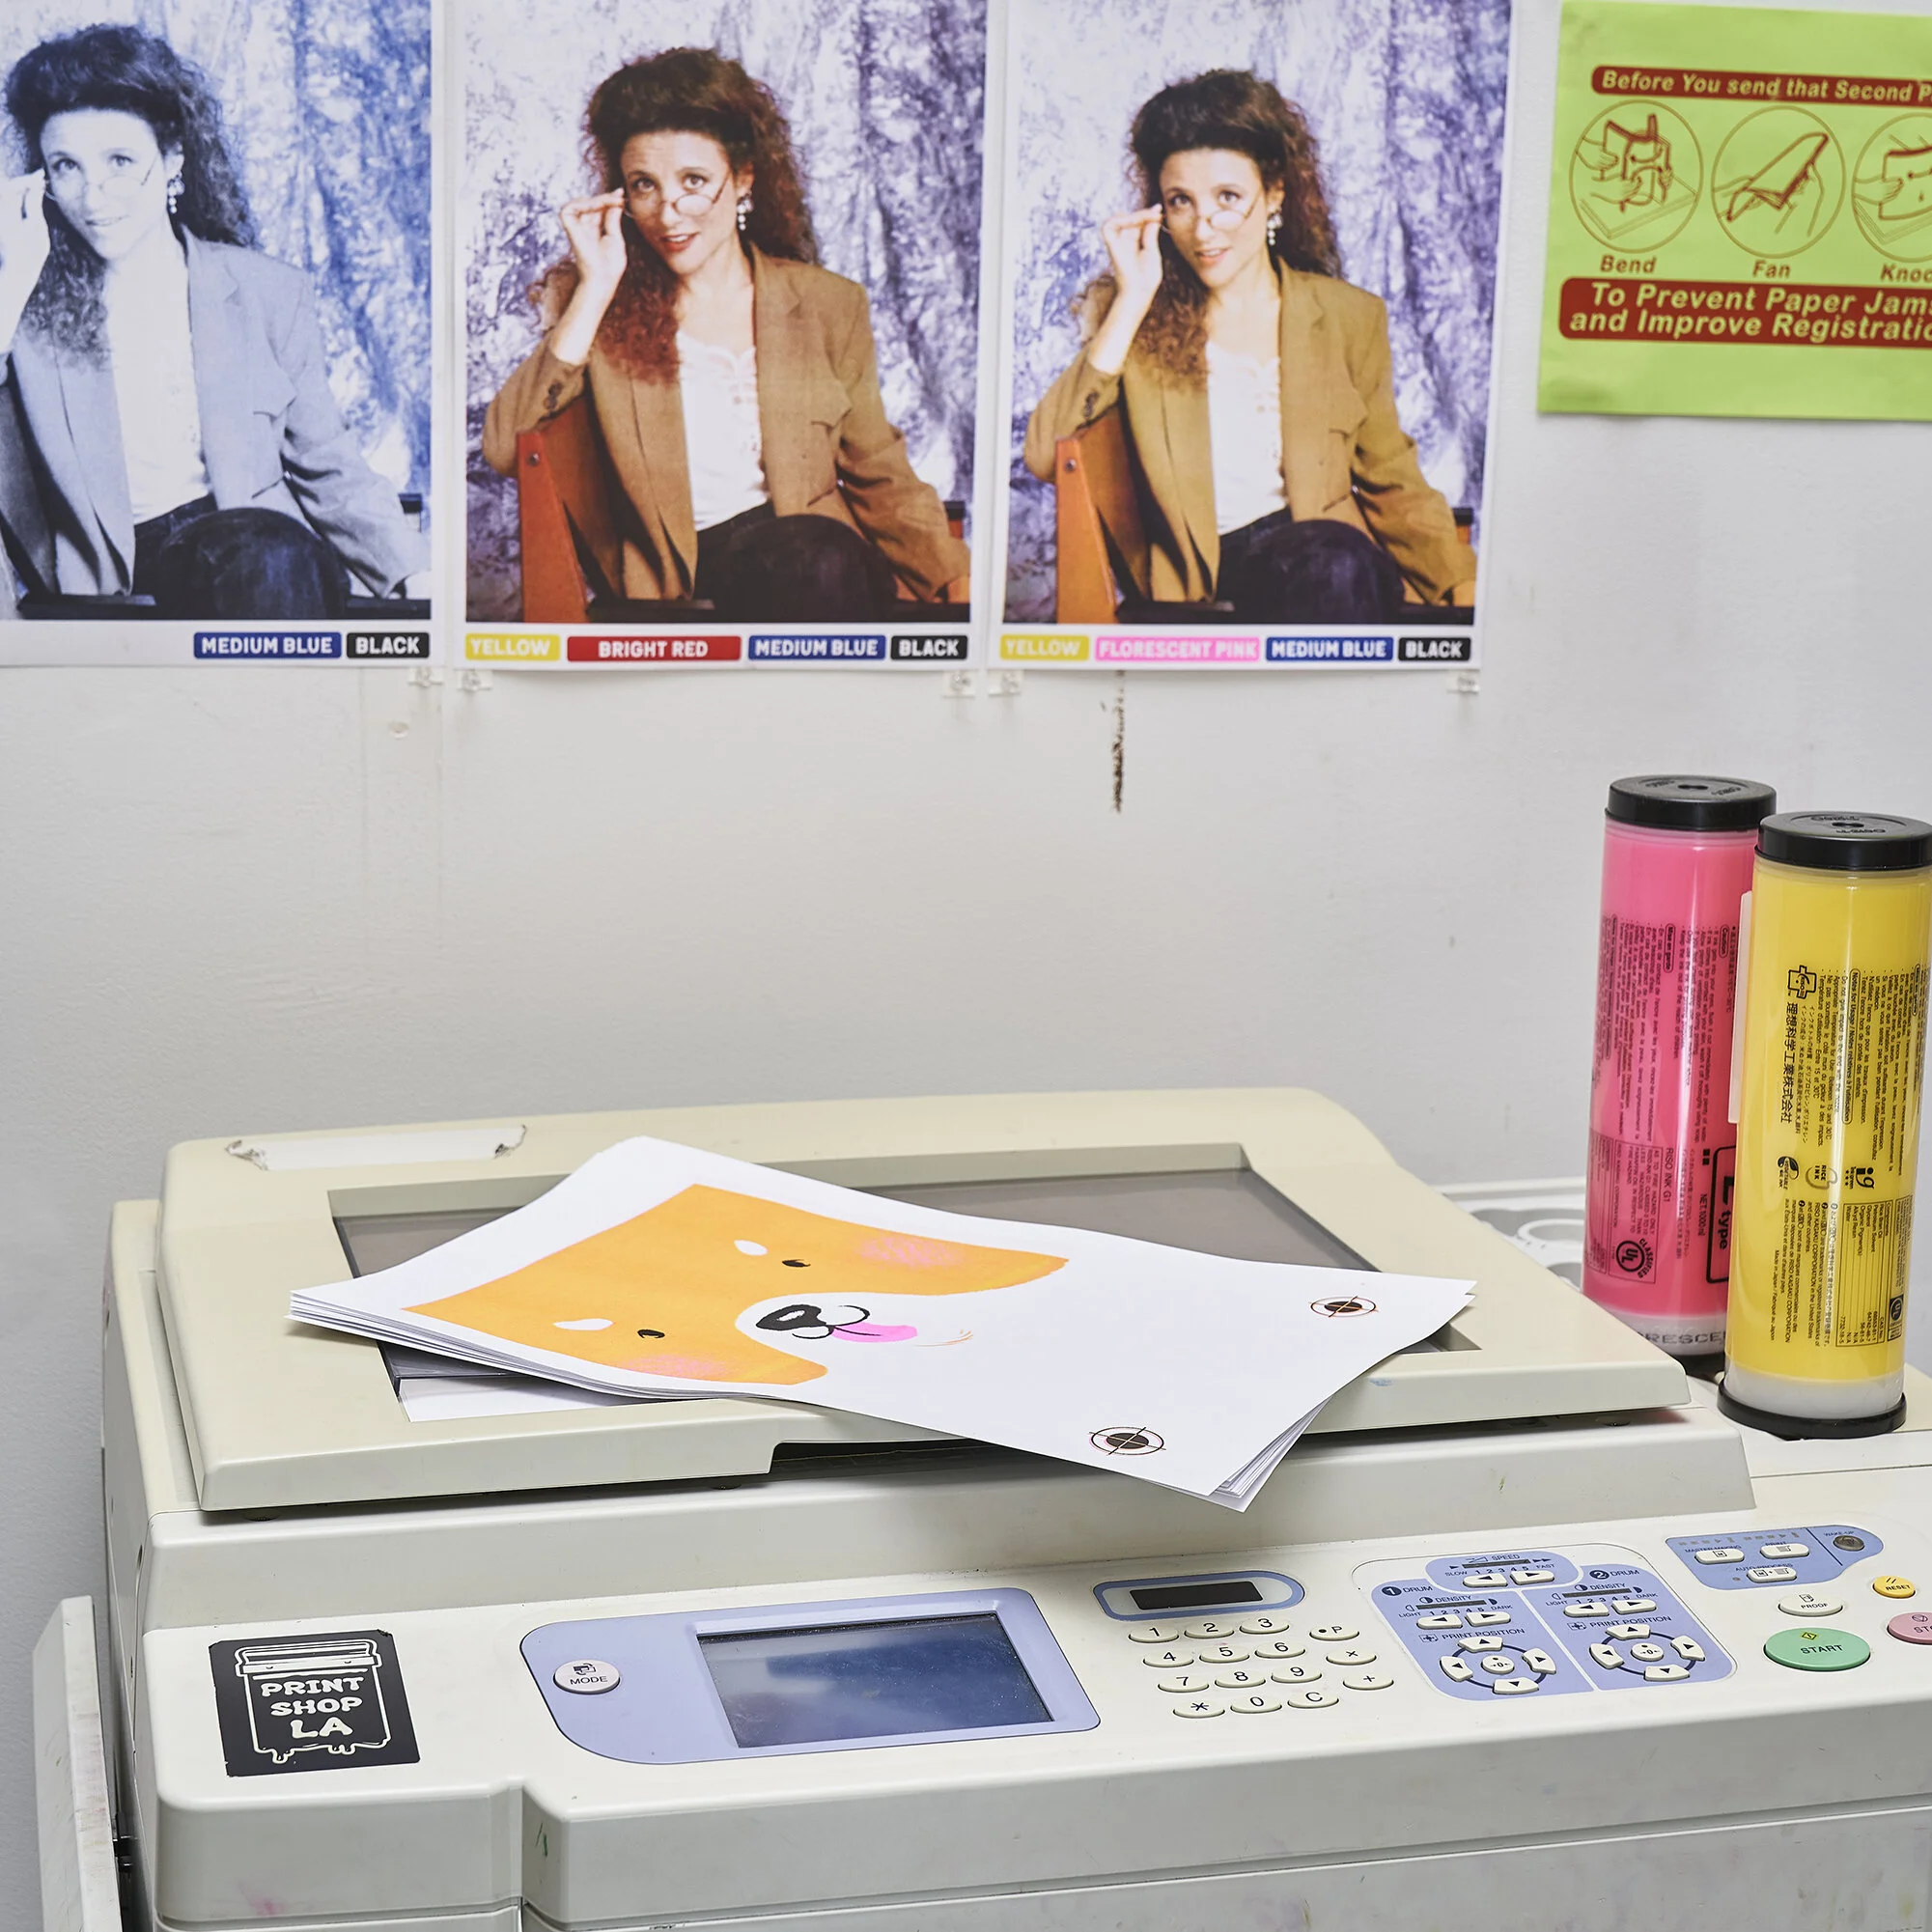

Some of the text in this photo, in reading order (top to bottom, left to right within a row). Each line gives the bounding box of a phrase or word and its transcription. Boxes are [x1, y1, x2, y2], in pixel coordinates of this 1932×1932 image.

[1602, 70, 1674, 92] Before
[1683, 73, 1721, 94] You
[1726, 76, 1780, 96] send
[1786, 77, 1829, 98] that
[1834, 79, 1913, 102] Second
[1600, 254, 1657, 273] Bend
[1751, 259, 1791, 278] Fan
[1591, 282, 1626, 307] To
[1636, 283, 1756, 311] Prevent
[1765, 287, 1857, 318] Paper
[1570, 308, 1629, 332] and
[1638, 309, 1761, 340] Improve
[201, 636, 420, 655] MEDIUM BLUE BLACK
[470, 638, 959, 658] YELLOW BRIGHT RED MEDIUM BLUE BLACK
[1006, 639, 1463, 658] YELLOW FLORESCENT PINK MEDIUM BLUE BLACK
[1848, 1004, 1857, 1024] Usage
[1780, 1002, 1798, 1124] 理想科学工業株式会社
[1663, 1148, 1674, 1202] RISO INK G1
[1718, 1210, 1731, 1249] type
[1622, 1248, 1638, 1263] UL
[1637, 1238, 1654, 1278] CLASSIFIED
[1149, 1617, 1343, 1638] 1 2 3 P
[1162, 1642, 1289, 1662] 4 5 6
[1800, 1644, 1843, 1655] START
[261, 1676, 364, 1697] PRINT
[570, 1675, 608, 1686] MODE
[1176, 1666, 1304, 1687] 7 8 9
[270, 1696, 363, 1717] SHOP
[1249, 1692, 1323, 1707] 0 C
[290, 1717, 353, 1739] LA
